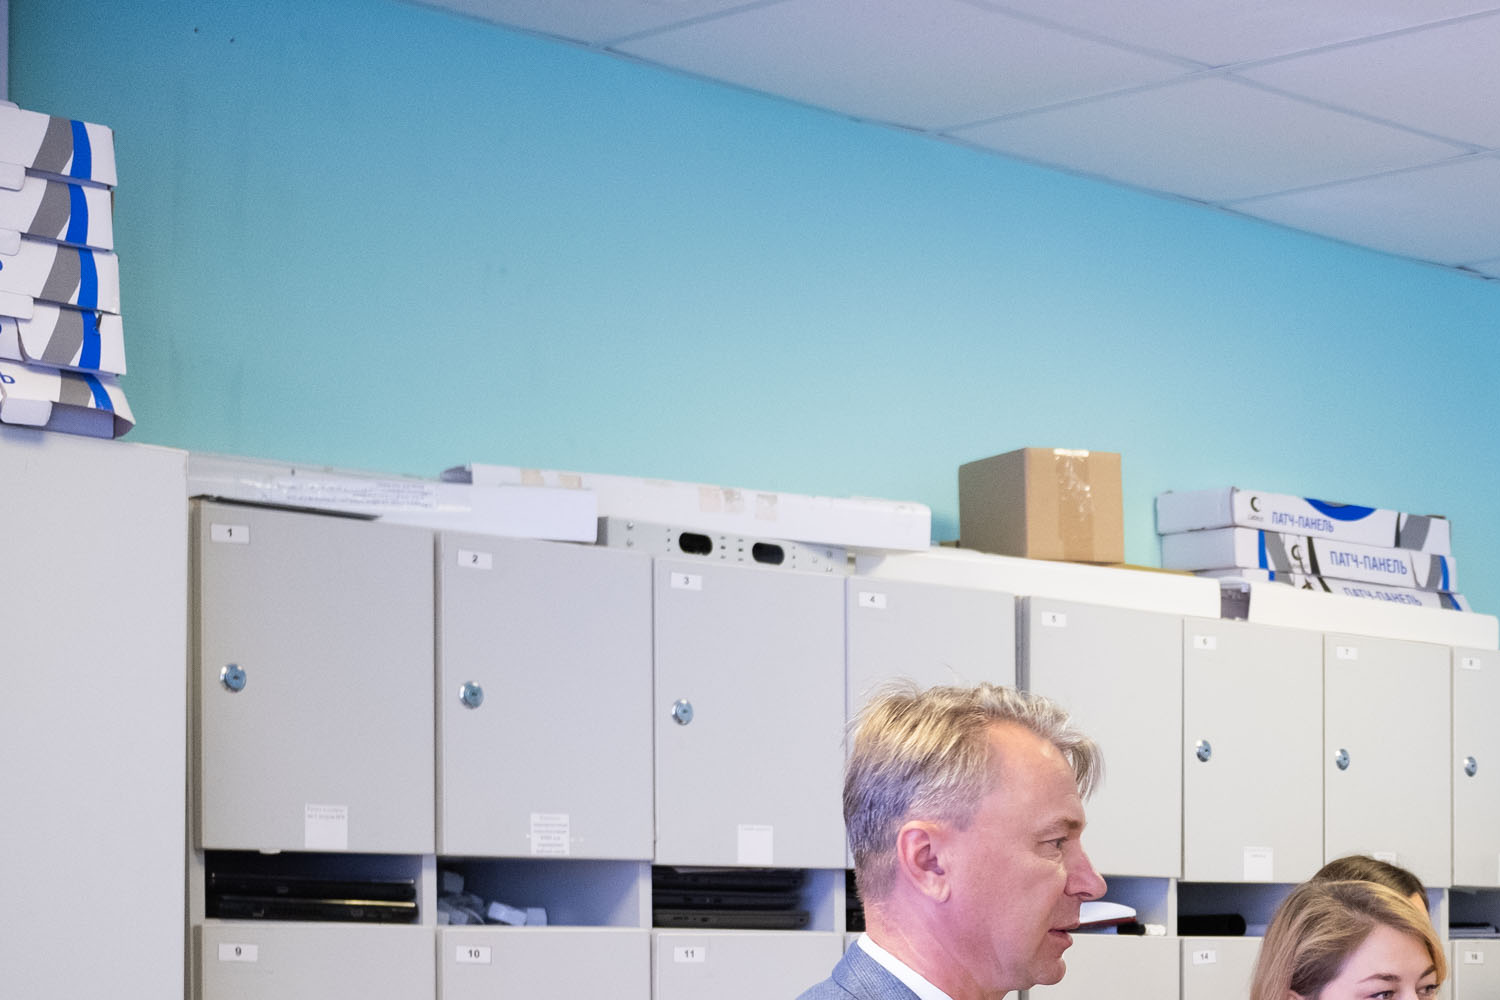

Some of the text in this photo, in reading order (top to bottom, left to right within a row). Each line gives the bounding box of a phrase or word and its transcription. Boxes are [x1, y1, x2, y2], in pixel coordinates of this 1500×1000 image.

[1271, 511, 1334, 533] ПАТЧ-ПАНЕЛЬ
[227, 527, 233, 538] 1
[472, 554, 479, 565] 2
[1329, 550, 1408, 575] ПАТЧ-ПАНЕЛЬ
[683, 576, 690, 586] 3
[235, 946, 242, 957] 9
[468, 949, 480, 959] 10
[684, 949, 695, 958] 11
[1199, 952, 1209, 961] 14
